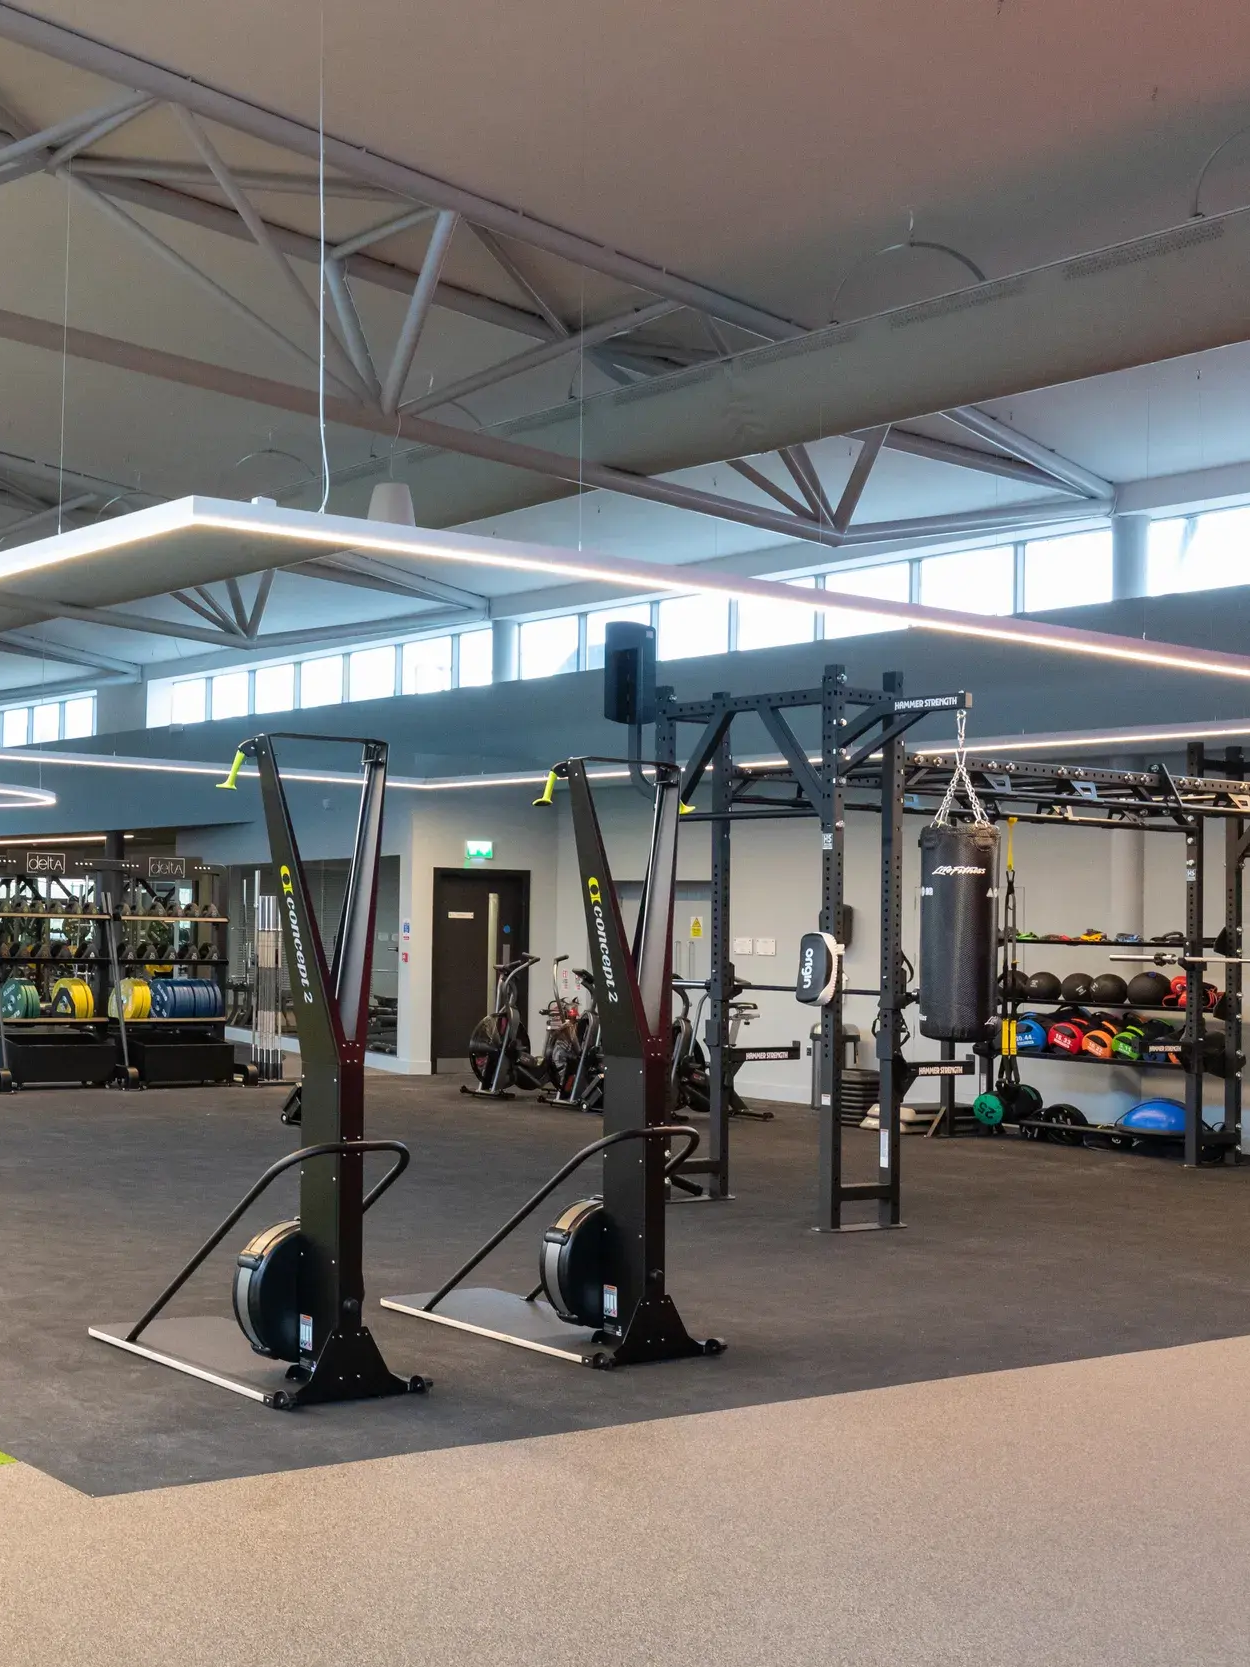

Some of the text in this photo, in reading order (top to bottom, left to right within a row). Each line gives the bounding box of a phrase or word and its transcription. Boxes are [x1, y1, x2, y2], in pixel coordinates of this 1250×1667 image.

[894, 696, 958, 711] HAMMER STRENGTH
[286, 896, 313, 1004] concept 2
[593, 905, 618, 1003] concept 2
[918, 1066, 940, 1075] HAMMER
[977, 1101, 997, 1119] 25
